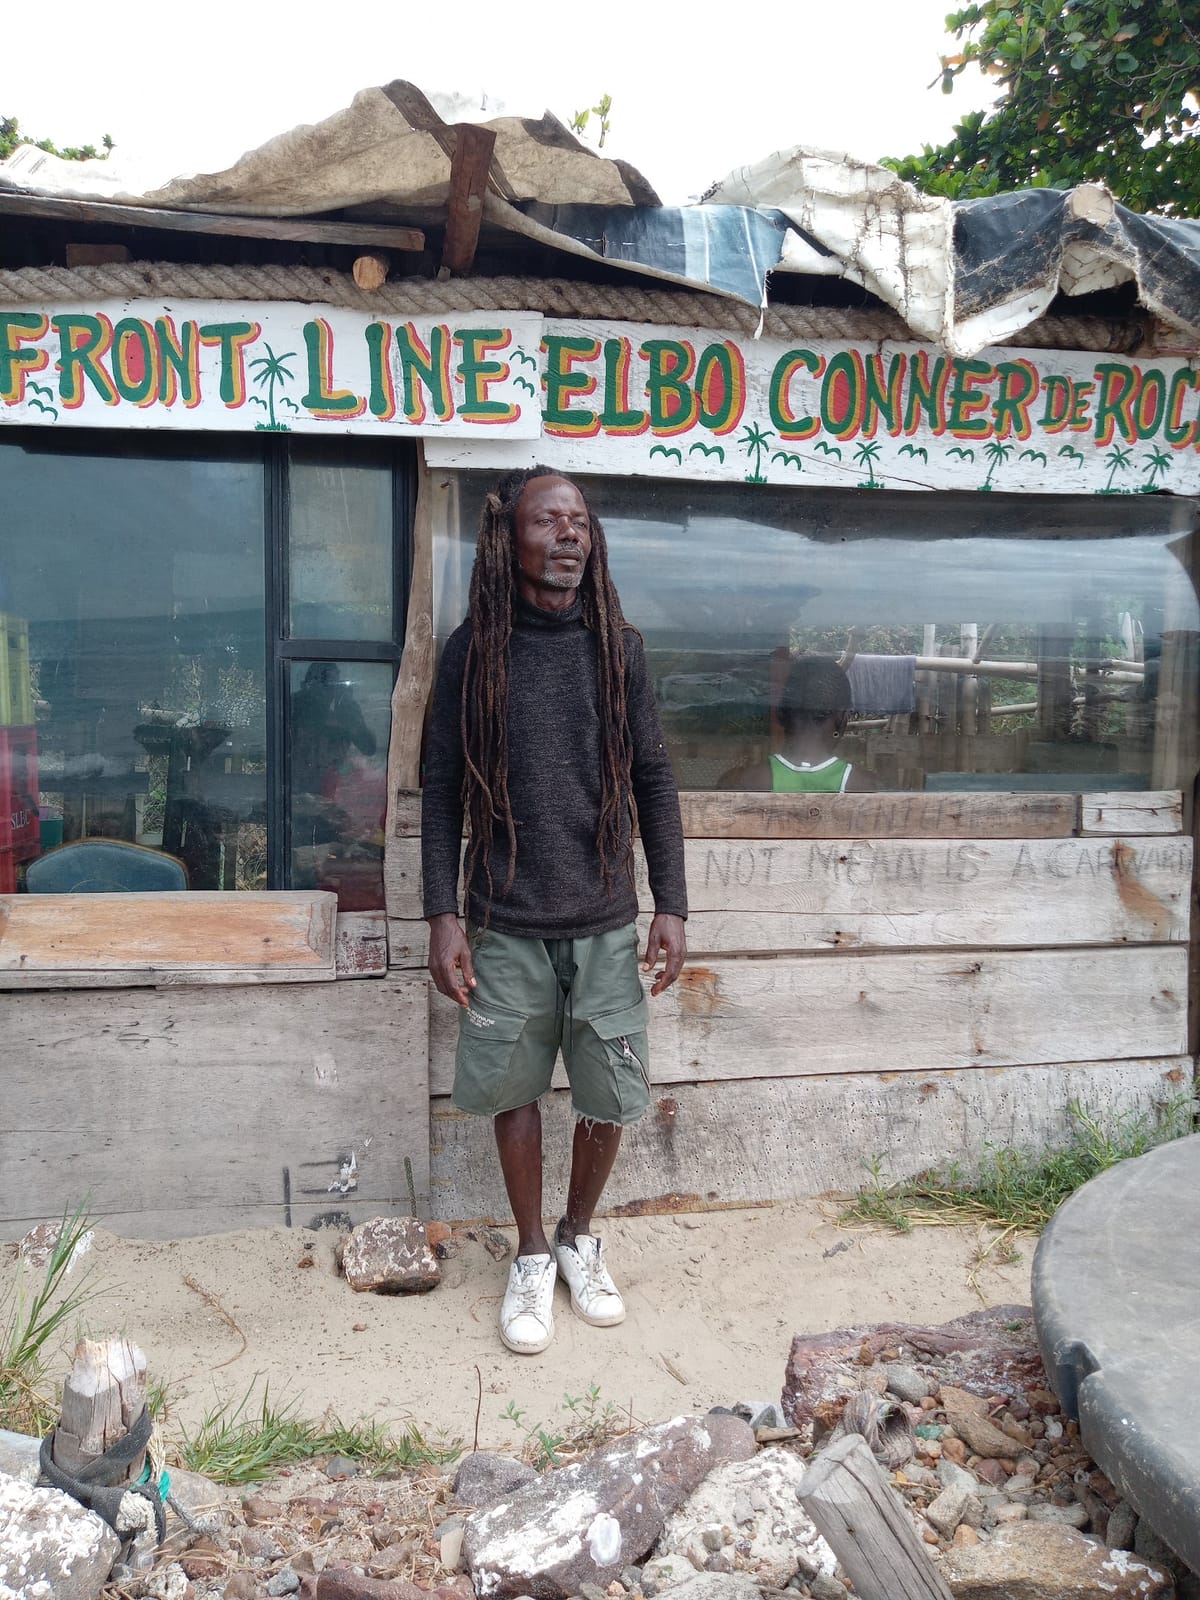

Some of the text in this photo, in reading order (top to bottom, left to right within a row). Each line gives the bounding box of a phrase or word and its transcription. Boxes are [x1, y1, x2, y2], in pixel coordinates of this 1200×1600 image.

[0, 312, 521, 424] FRONT LINE
[540, 334, 1200, 454] ELBO CONNER DE ROC
[704, 846, 783, 888] NOT
